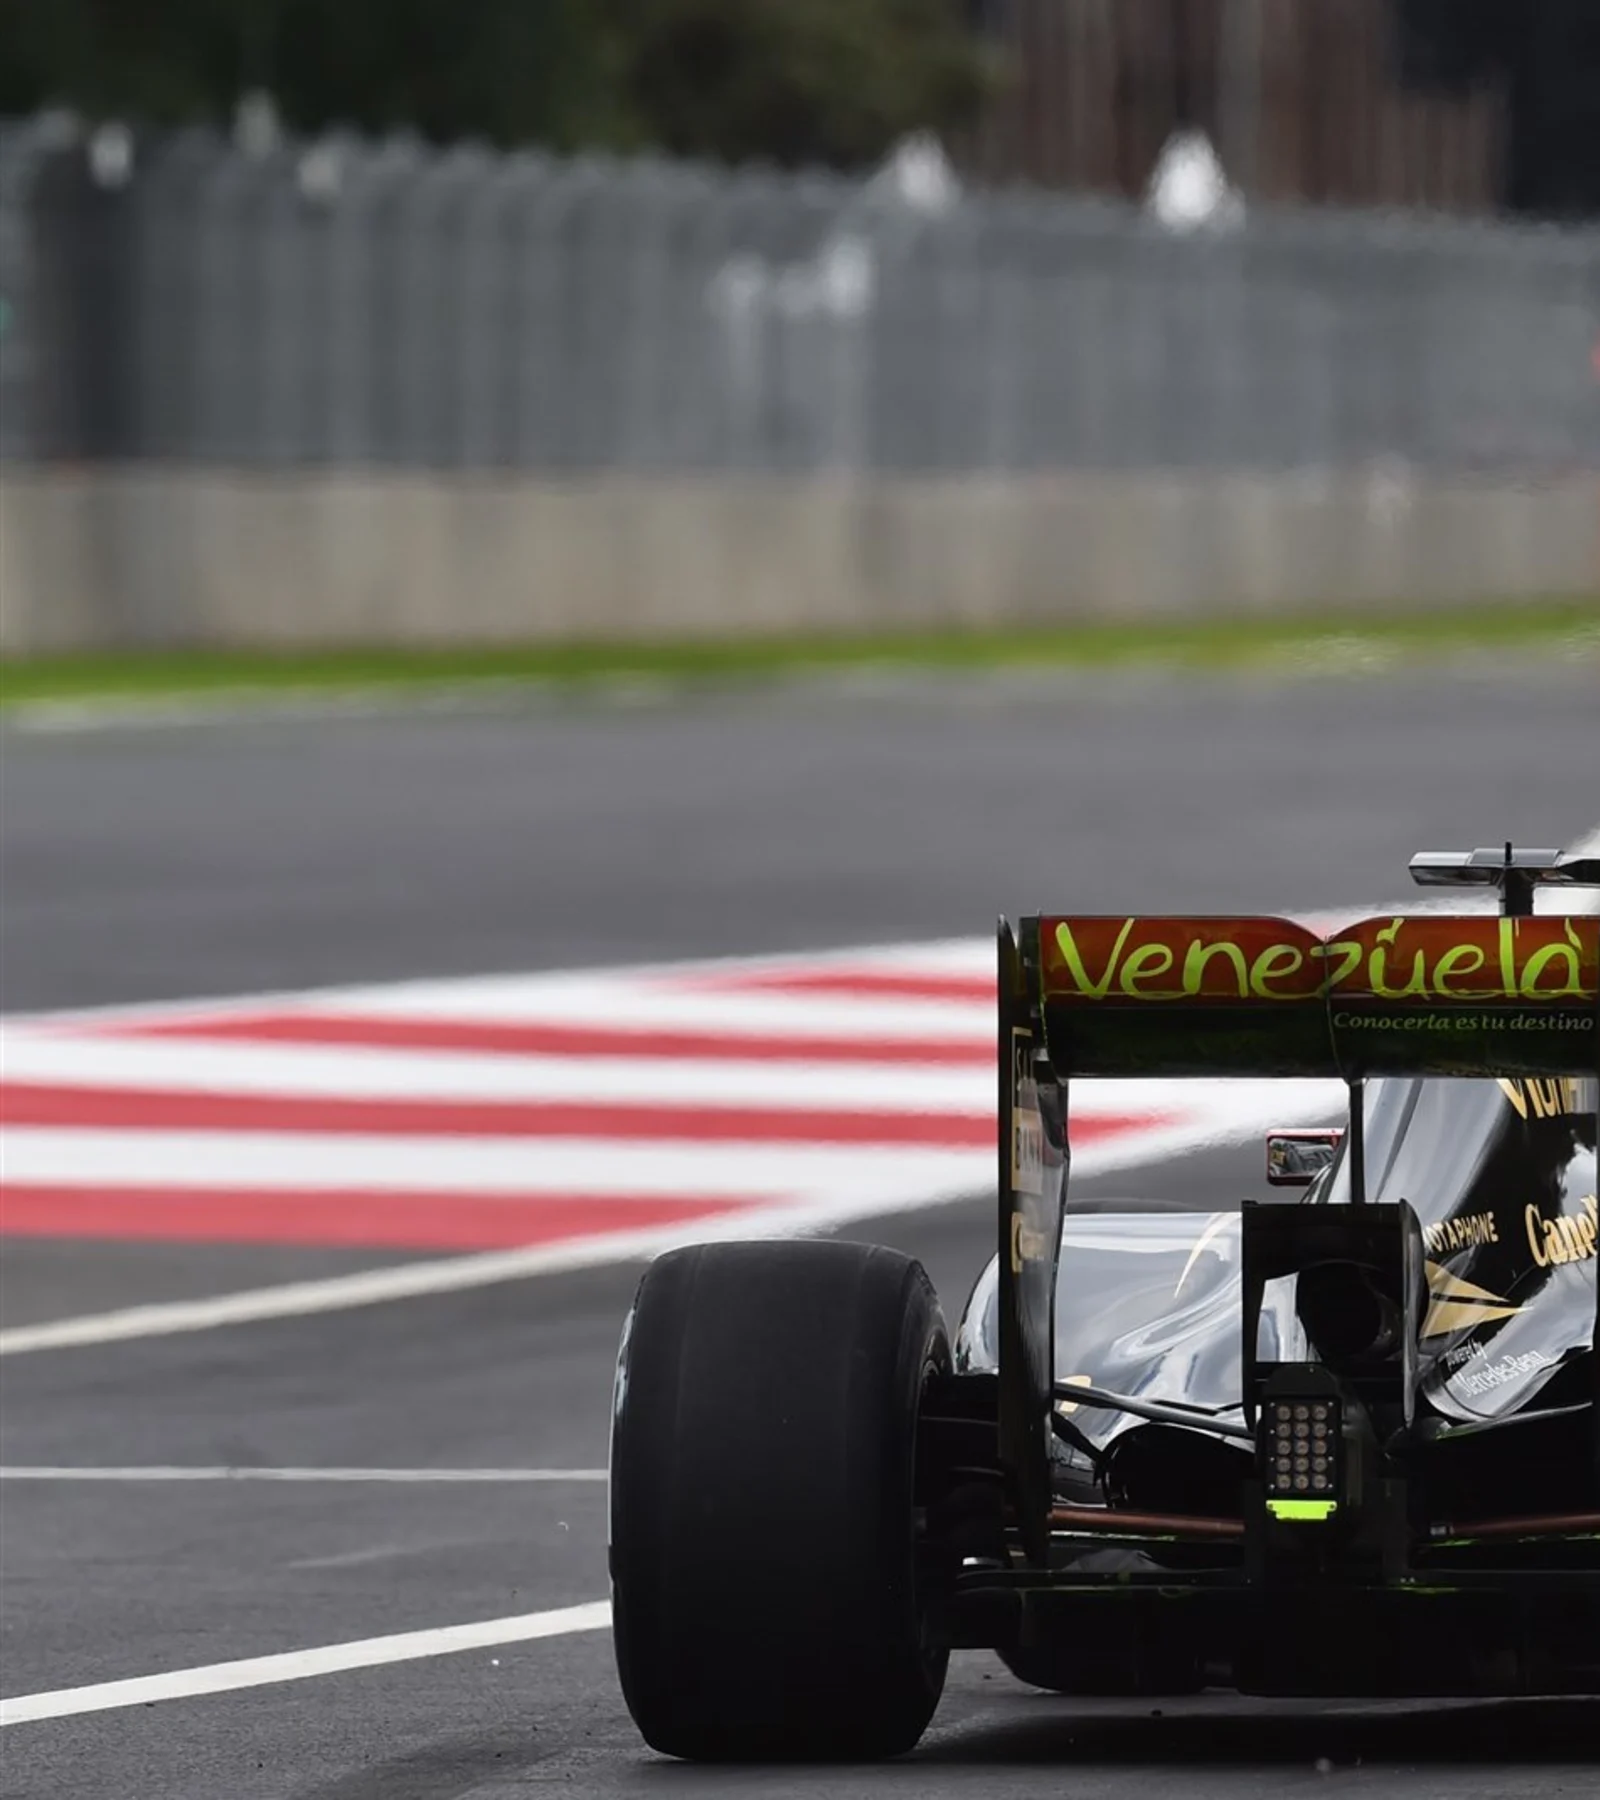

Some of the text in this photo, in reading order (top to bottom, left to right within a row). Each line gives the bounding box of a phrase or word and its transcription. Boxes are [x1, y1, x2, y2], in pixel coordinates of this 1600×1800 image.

[1333, 1012, 1593, 1030] Conocerla es tu destino
